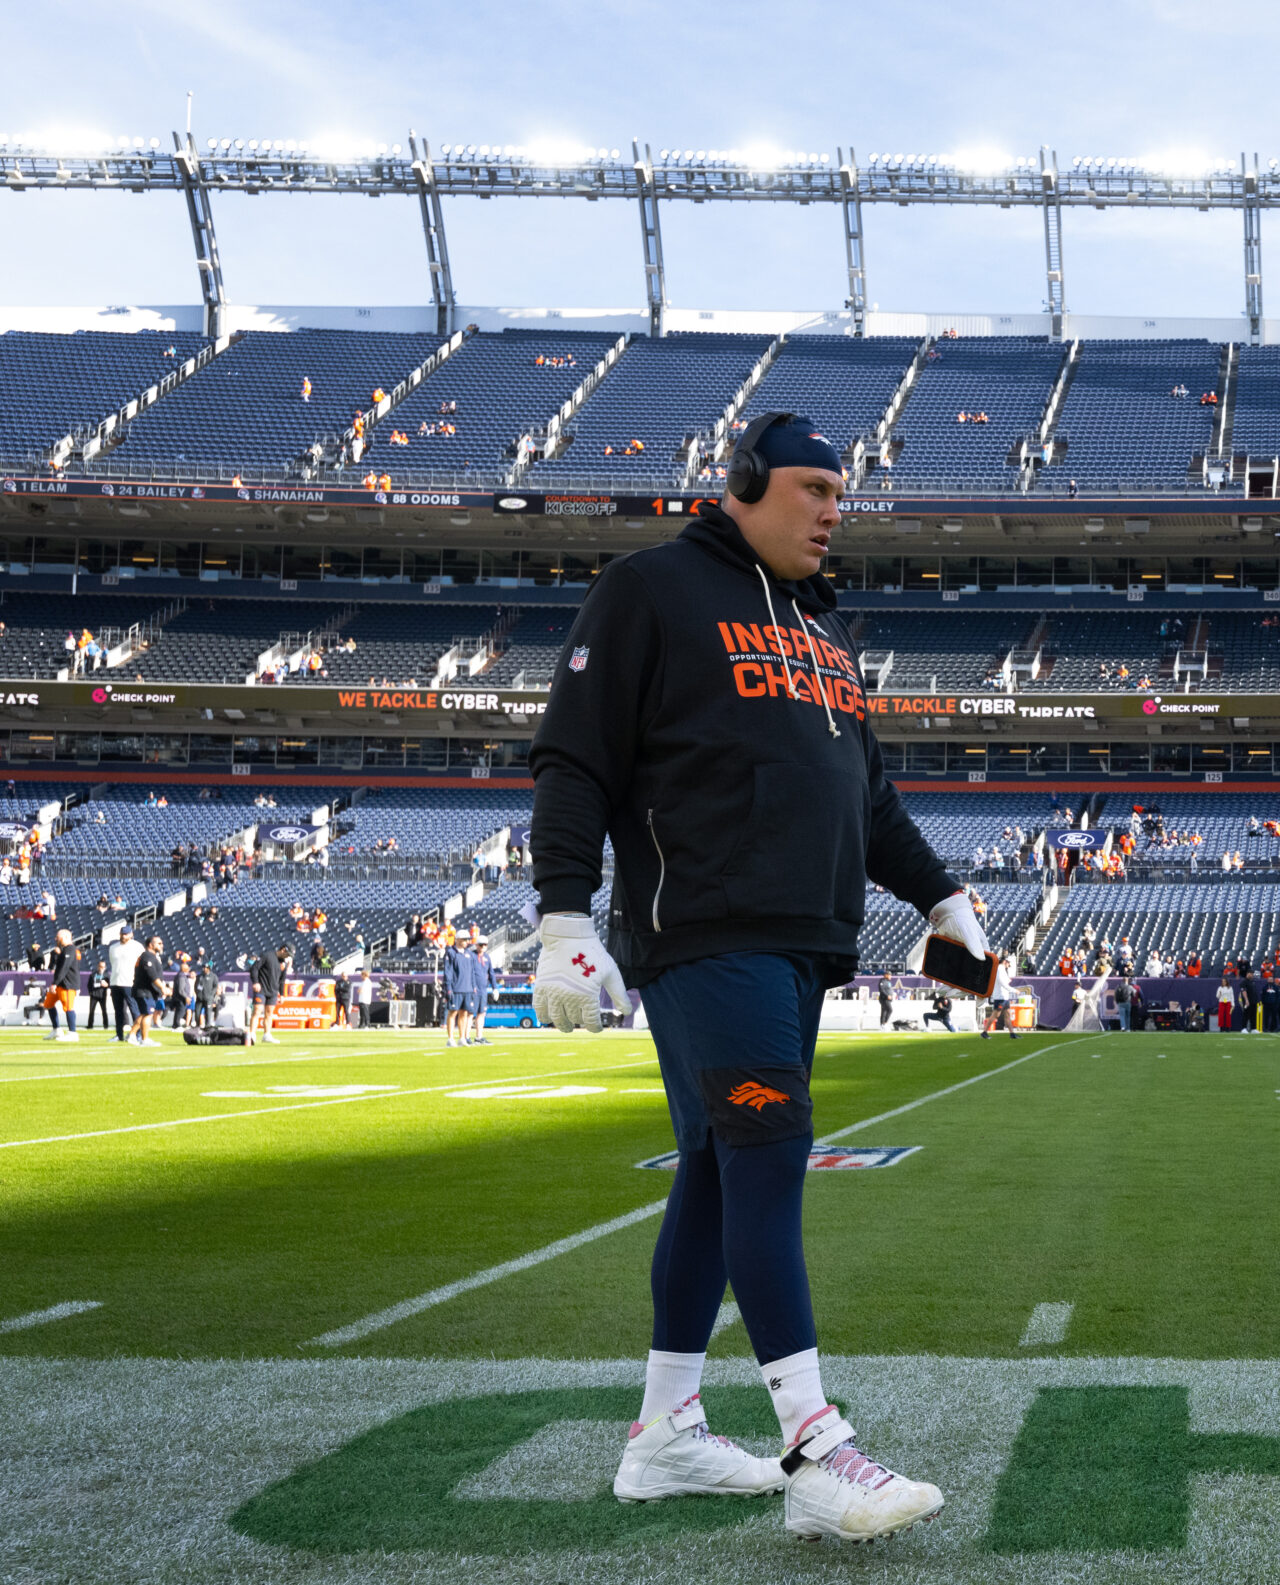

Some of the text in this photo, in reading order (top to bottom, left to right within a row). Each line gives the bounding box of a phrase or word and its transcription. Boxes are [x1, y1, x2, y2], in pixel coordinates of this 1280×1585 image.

[22, 482, 67, 493] 1 ELAM
[118, 485, 186, 498] 24 BAILEY
[254, 489, 324, 501] SHANAHAN
[392, 493, 461, 505] 88 ODOMS
[545, 495, 597, 503] COUNTDOWN
[545, 502, 617, 515] KICKOFF
[853, 501, 894, 511] FOLEY
[717, 622, 857, 679] INSPIRE
[729, 654, 781, 662] OPPORTUNITY
[788, 658, 809, 669] EQUITY
[733, 662, 865, 721] CHANGE
[110, 692, 175, 703] CHECK POINT
[338, 692, 366, 708] WE
[370, 692, 437, 708] TACKLE
[441, 694, 498, 710] CYBER
[866, 698, 888, 713] WE
[892, 698, 956, 713] TACKLE
[960, 699, 1015, 714] CYBER
[1160, 704, 1220, 713] CHECK POINT
[234, 765, 249, 773] 121
[473, 769, 488, 777] 122
[970, 773, 984, 781] 124
[1207, 773, 1221, 781] 125
[278, 1007, 322, 1015] GATORADE
